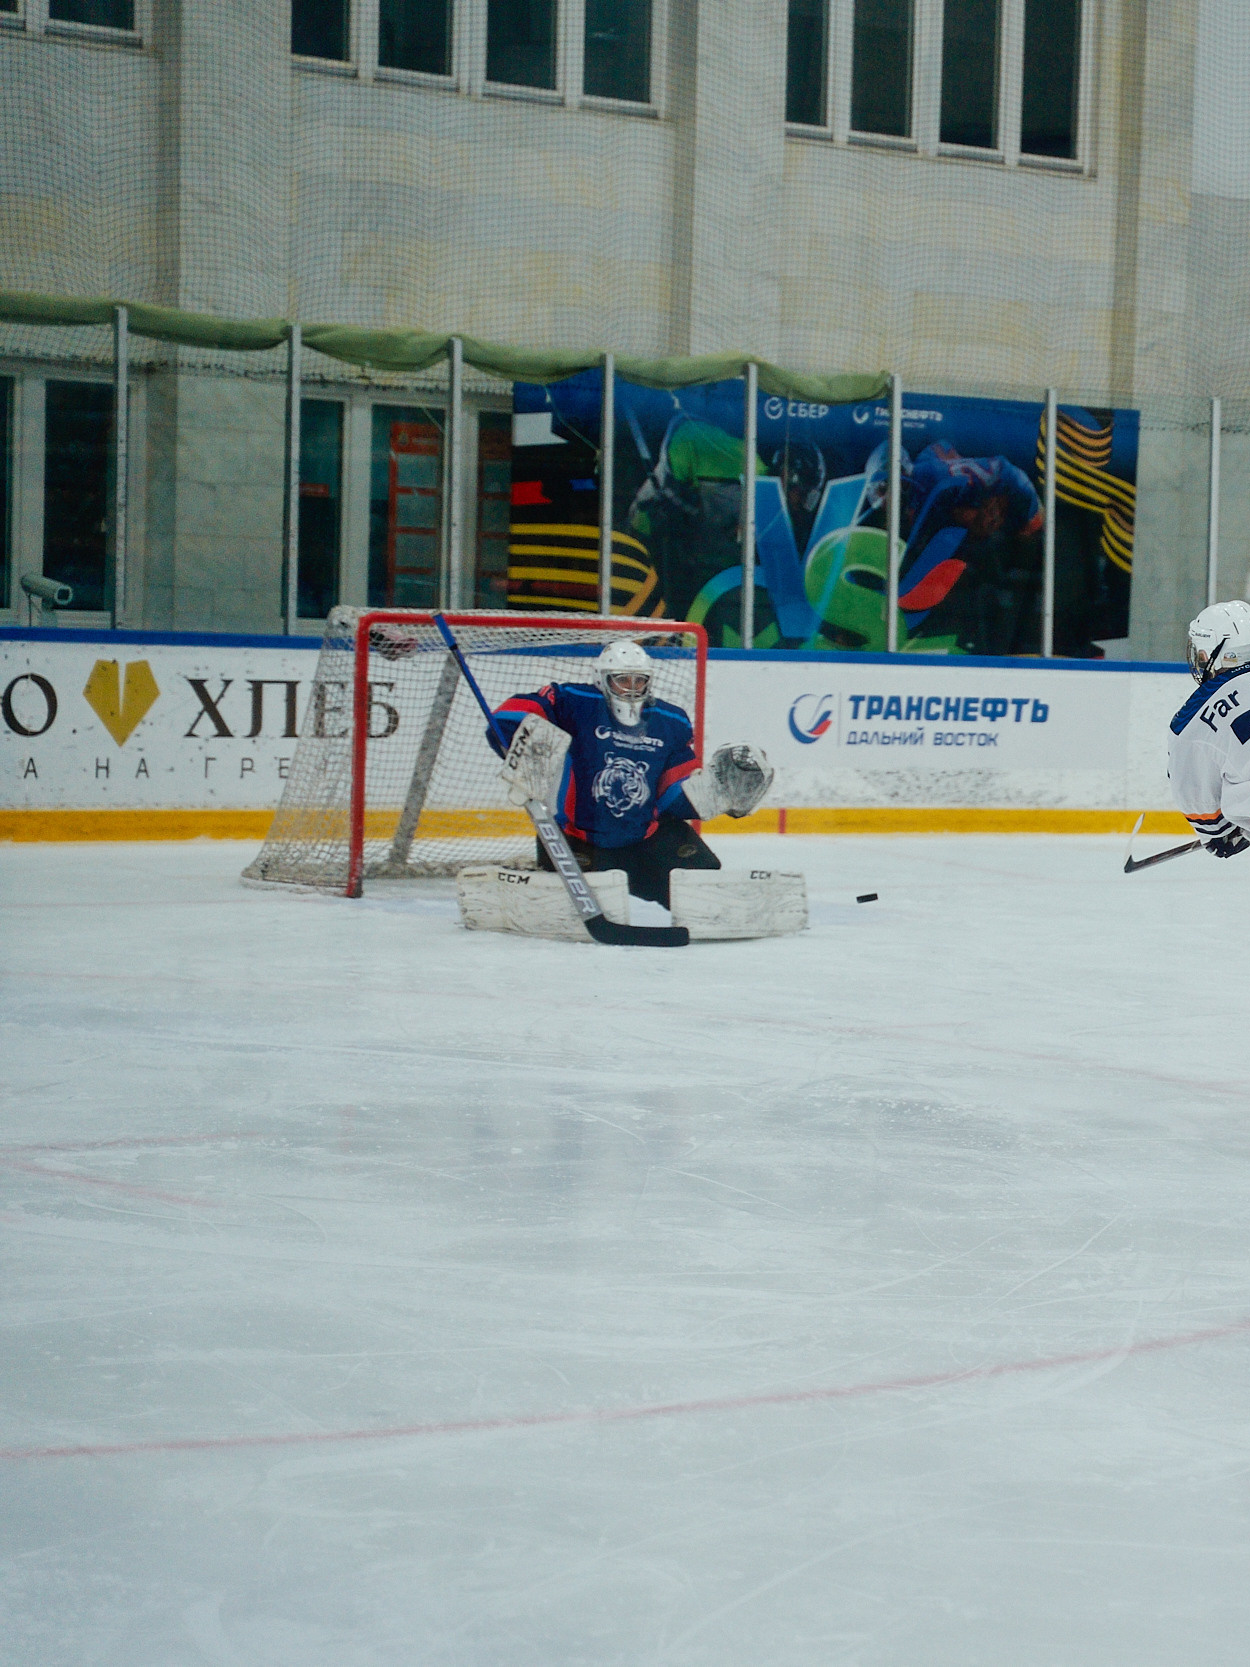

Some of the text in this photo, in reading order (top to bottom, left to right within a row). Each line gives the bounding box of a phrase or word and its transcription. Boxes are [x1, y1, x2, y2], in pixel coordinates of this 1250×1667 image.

[183, 677, 400, 738] ХЛЕБ
[848, 694, 1050, 723] ТРАНСНЕФТЬ
[1199, 689, 1241, 733] Far
[508, 727, 531, 770] CCM
[846, 726, 999, 747] ДАЛЬНИЙ ВОСТОК
[498, 872, 531, 885] CCM
